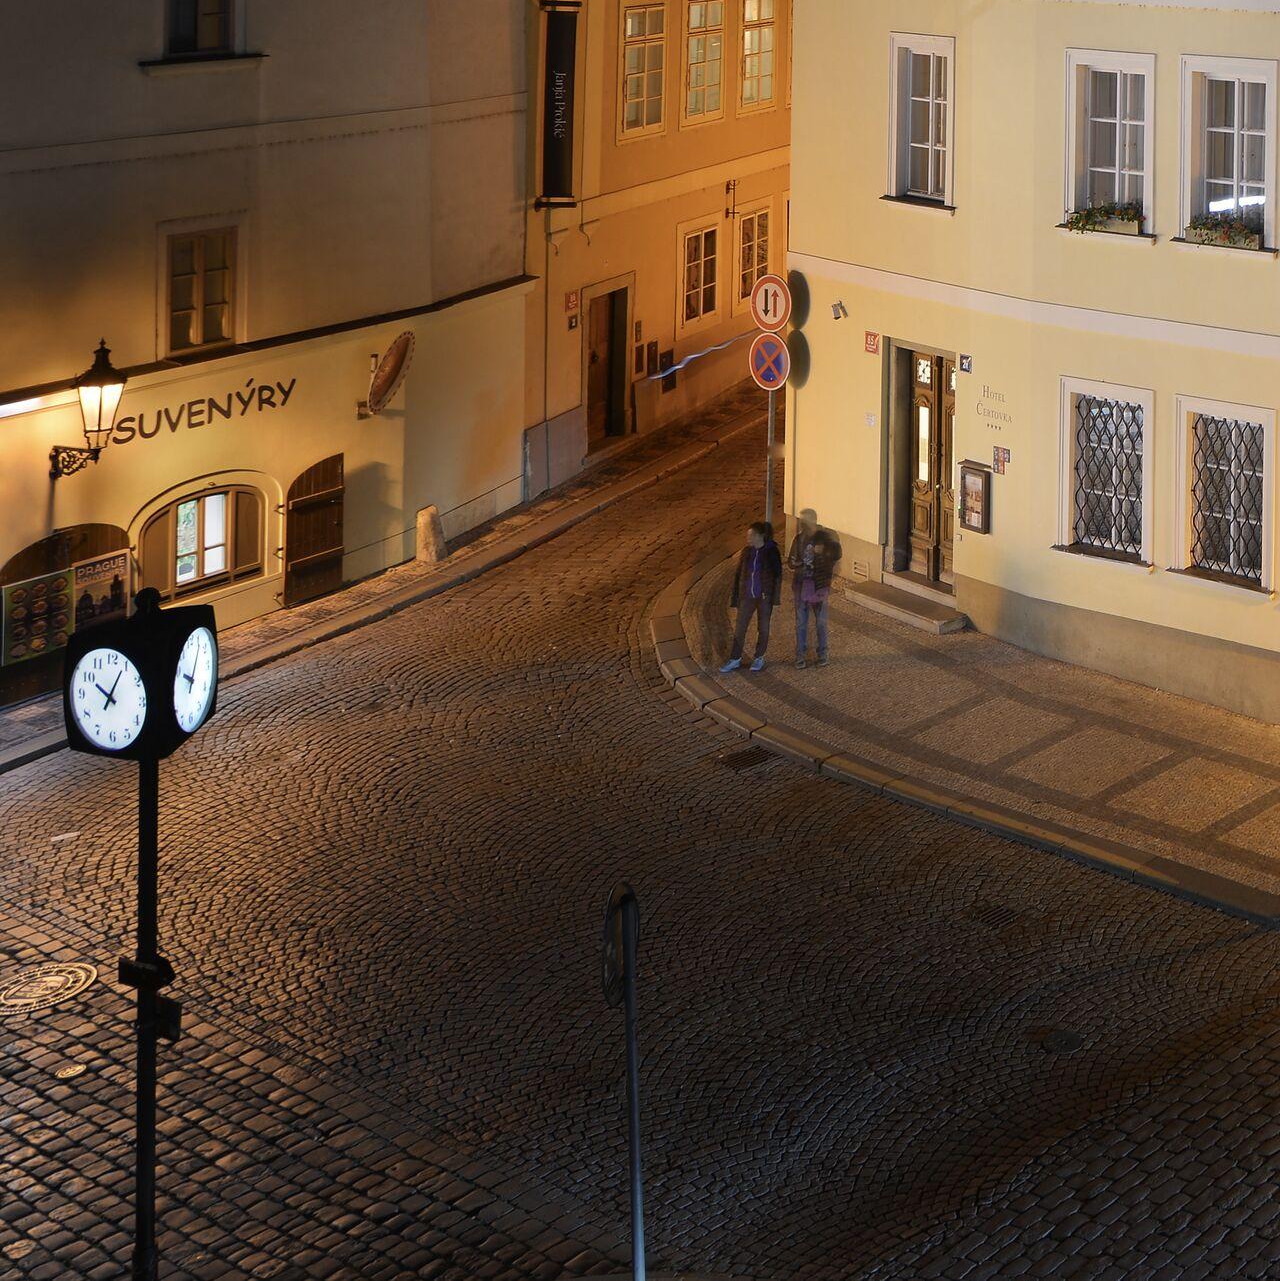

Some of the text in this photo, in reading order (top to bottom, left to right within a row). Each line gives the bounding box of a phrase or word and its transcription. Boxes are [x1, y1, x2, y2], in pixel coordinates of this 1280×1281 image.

[552, 71, 567, 99] Janja
[112, 377, 297, 445] SUVENÝRY
[77, 556, 126, 576] PRAGUE
[93, 657, 103, 670] 11
[107, 653, 118, 665] 12
[124, 660, 129, 672] 1
[83, 671, 95, 682] 10
[134, 675, 142, 687] 2
[78, 688, 86, 700] 9
[138, 696, 146, 708] 3
[83, 708, 91, 719] 8
[133, 714, 140, 726] 4
[94, 724, 102, 735] 7
[123, 728, 131, 739] 5
[109, 731, 117, 743] 6
